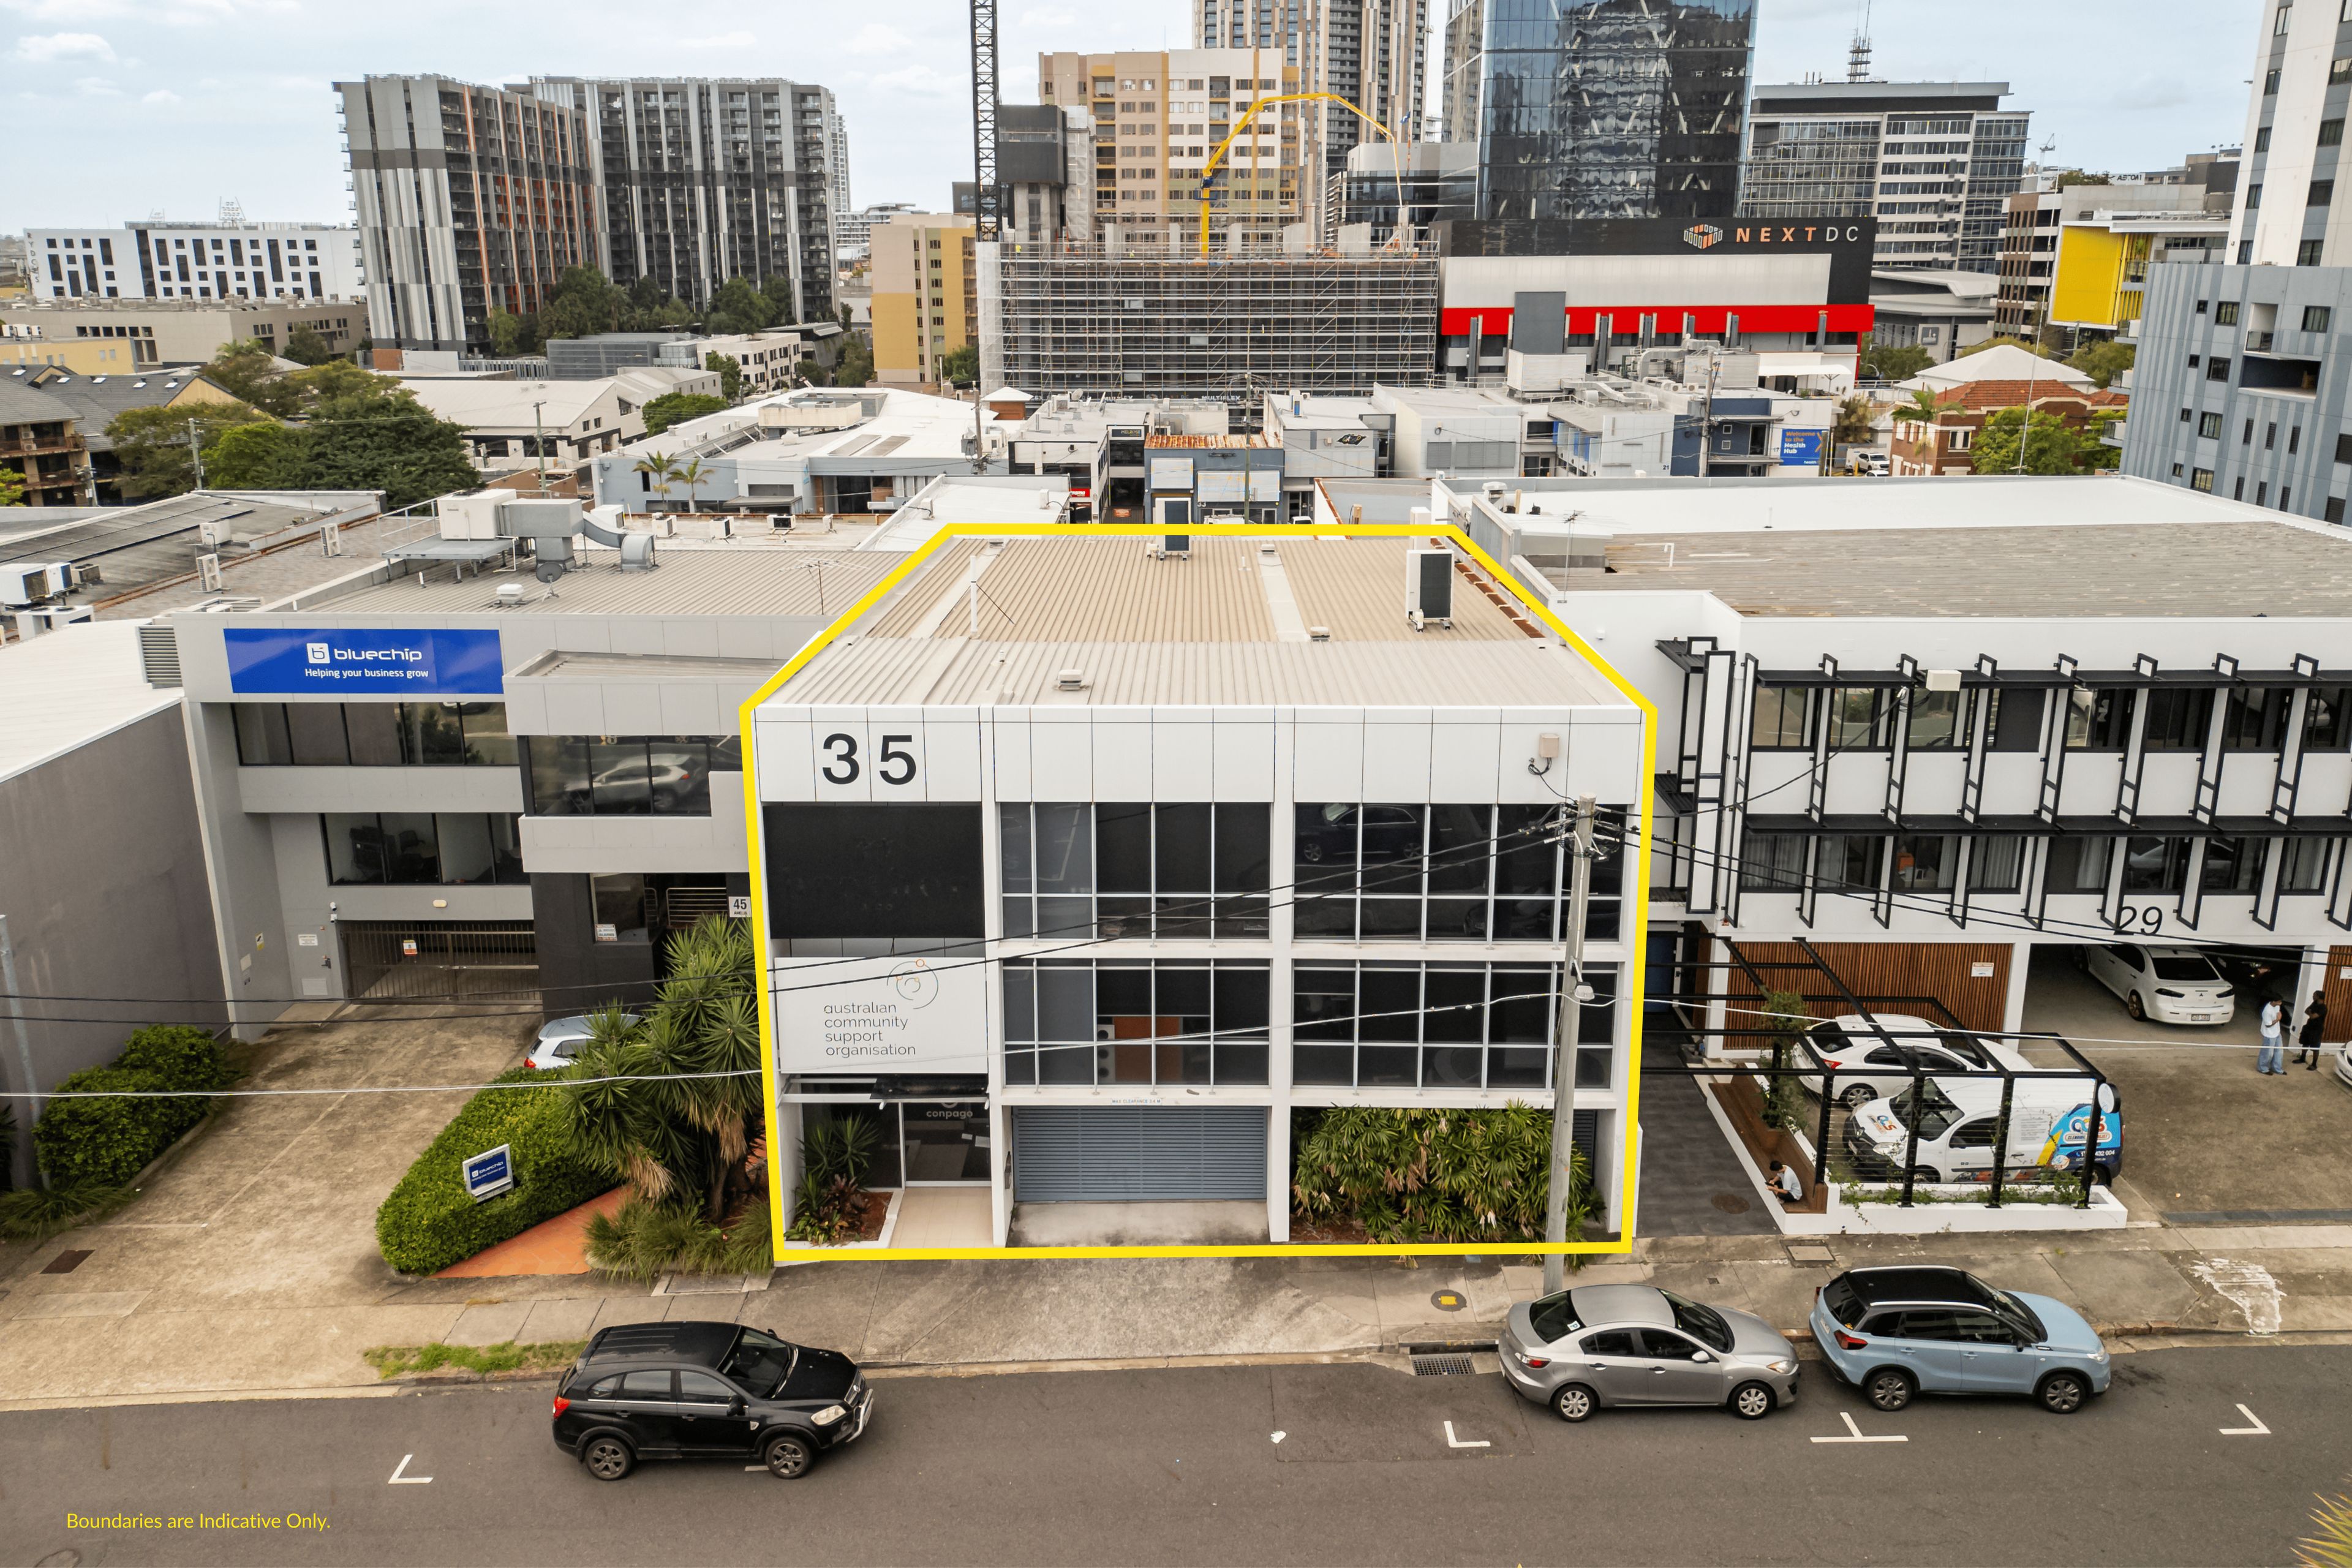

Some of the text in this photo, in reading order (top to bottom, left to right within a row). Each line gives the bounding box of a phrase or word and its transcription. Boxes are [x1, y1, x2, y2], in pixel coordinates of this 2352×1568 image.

[1736, 227, 1858, 242] NEXTDC
[27, 232, 40, 282] RYDGS
[334, 648, 422, 662] bluechip
[305, 668, 429, 679] Helping your business grow
[823, 733, 916, 785] 35
[734, 899, 747, 910] 45
[2114, 906, 2163, 936] 29
[824, 1001, 897, 1014] australian
[824, 1016, 908, 1030] community
[825, 1030, 883, 1044] support
[826, 1044, 916, 1058] organisation
[926, 1110, 973, 1120] conpago
